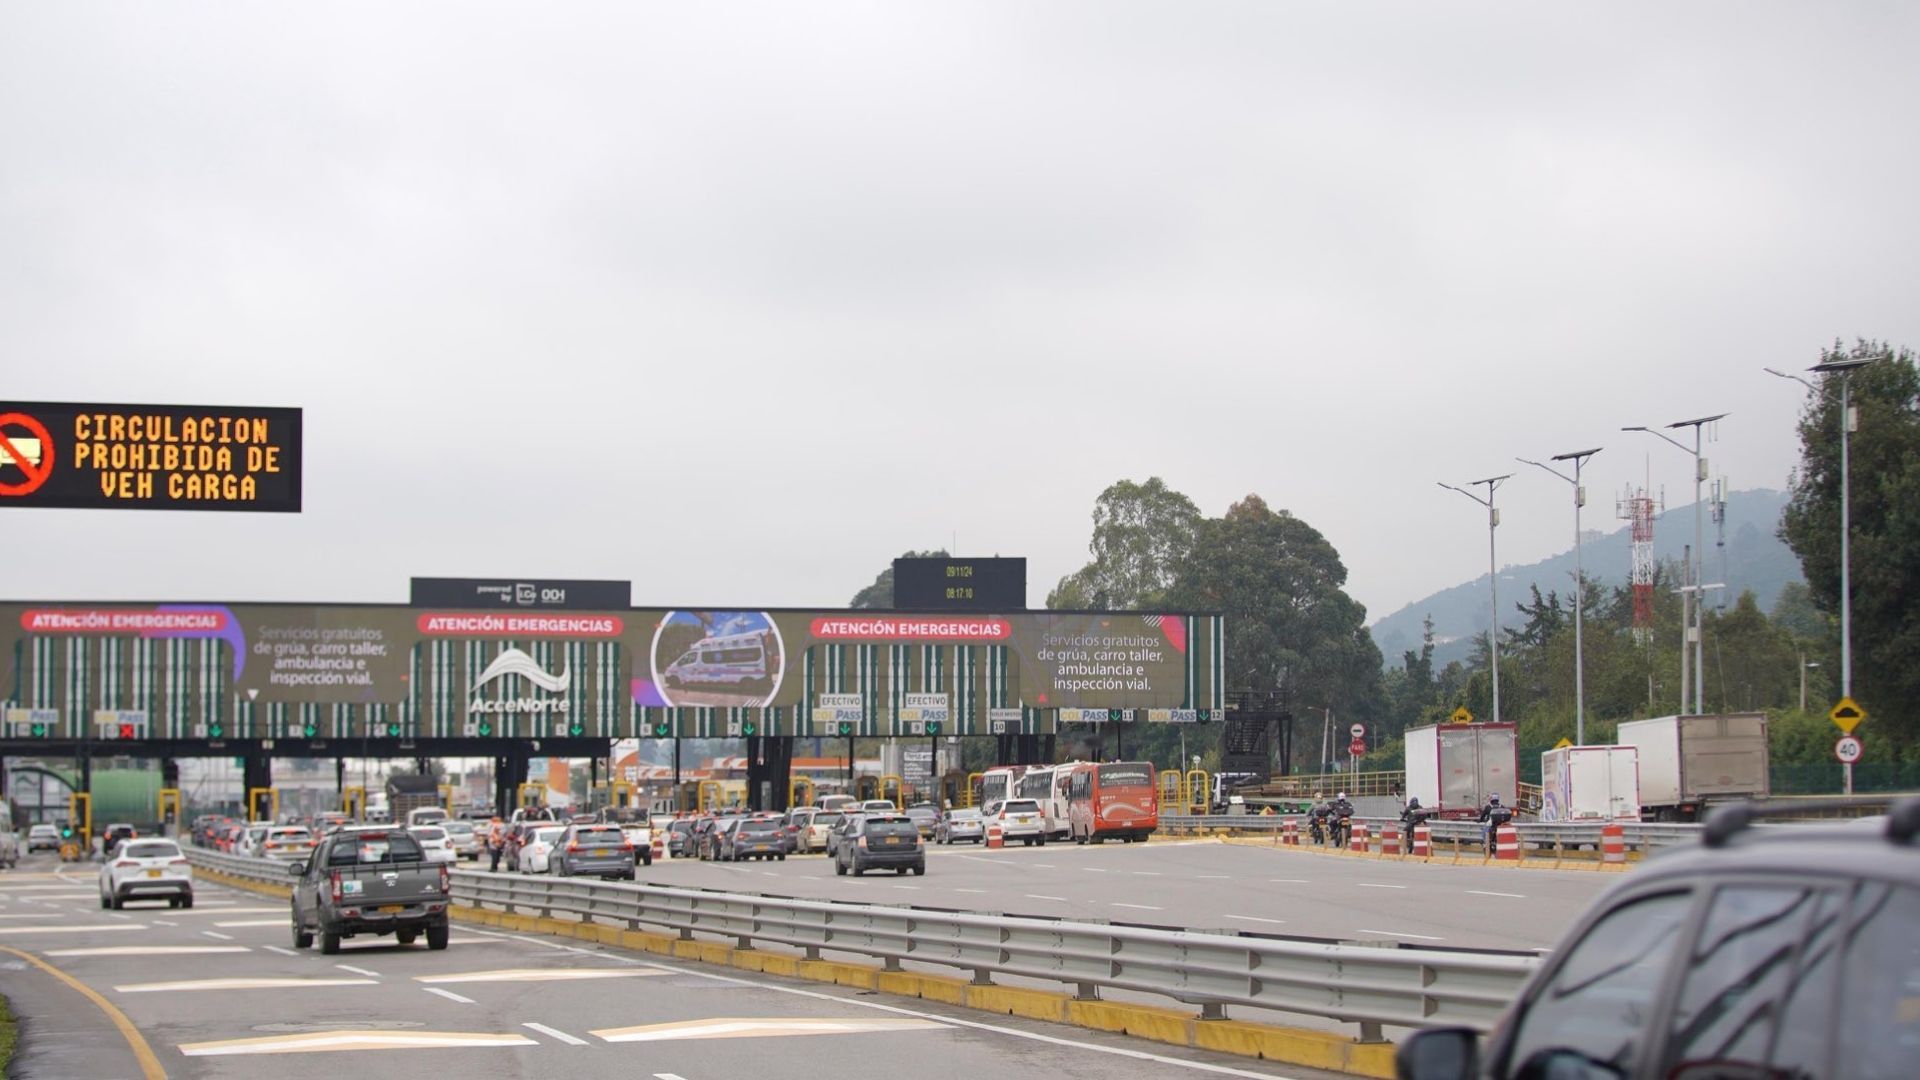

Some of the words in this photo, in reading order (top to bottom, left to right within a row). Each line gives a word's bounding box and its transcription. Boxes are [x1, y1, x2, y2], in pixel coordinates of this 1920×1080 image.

[75, 414, 268, 444] CIRCULACION
[75, 442, 231, 471] PROHIBIDA
[248, 446, 280, 472] DE
[101, 471, 152, 498] VEH
[168, 473, 256, 500] CARGA
[33, 611, 109, 627] ATENCIÓN
[112, 614, 217, 628] EMERGENCIAS
[428, 615, 505, 631] ATENCIÓN
[508, 618, 613, 632] EMERGENCIAS
[259, 626, 319, 640] Servicios
[321, 627, 383, 642] gratuitos
[821, 620, 895, 635] ATENCIÓN
[899, 623, 1001, 636] EMERGENCIAS
[1043, 633, 1100, 647] Servicios
[1102, 634, 1160, 649] gratuitos
[254, 642, 271, 654] de
[312, 645, 346, 655] carro
[349, 643, 387, 656] taller,
[1037, 648, 1055, 661] de
[1057, 649, 1091, 664] grúa,
[1094, 651, 1126, 662] carro
[1129, 649, 1164, 664] taller,
[274, 656, 353, 670] ambulancia
[356, 659, 366, 670] e
[1058, 663, 1133, 676] ambulancia
[1136, 666, 1144, 676] e
[270, 672, 343, 686] inspección
[346, 672, 373, 685] vial.
[1054, 678, 1123, 692] inspección
[1126, 678, 1151, 691] vial.
[470, 697, 570, 713] AcceNorte
[822, 695, 861, 706] EFECTIVO
[907, 695, 946, 706] EFECTIVO
[1123, 710, 1132, 720] 11
[1211, 710, 1221, 720] 12
[995, 723, 1004, 731] 10
[1840, 743, 1857, 756] 40
